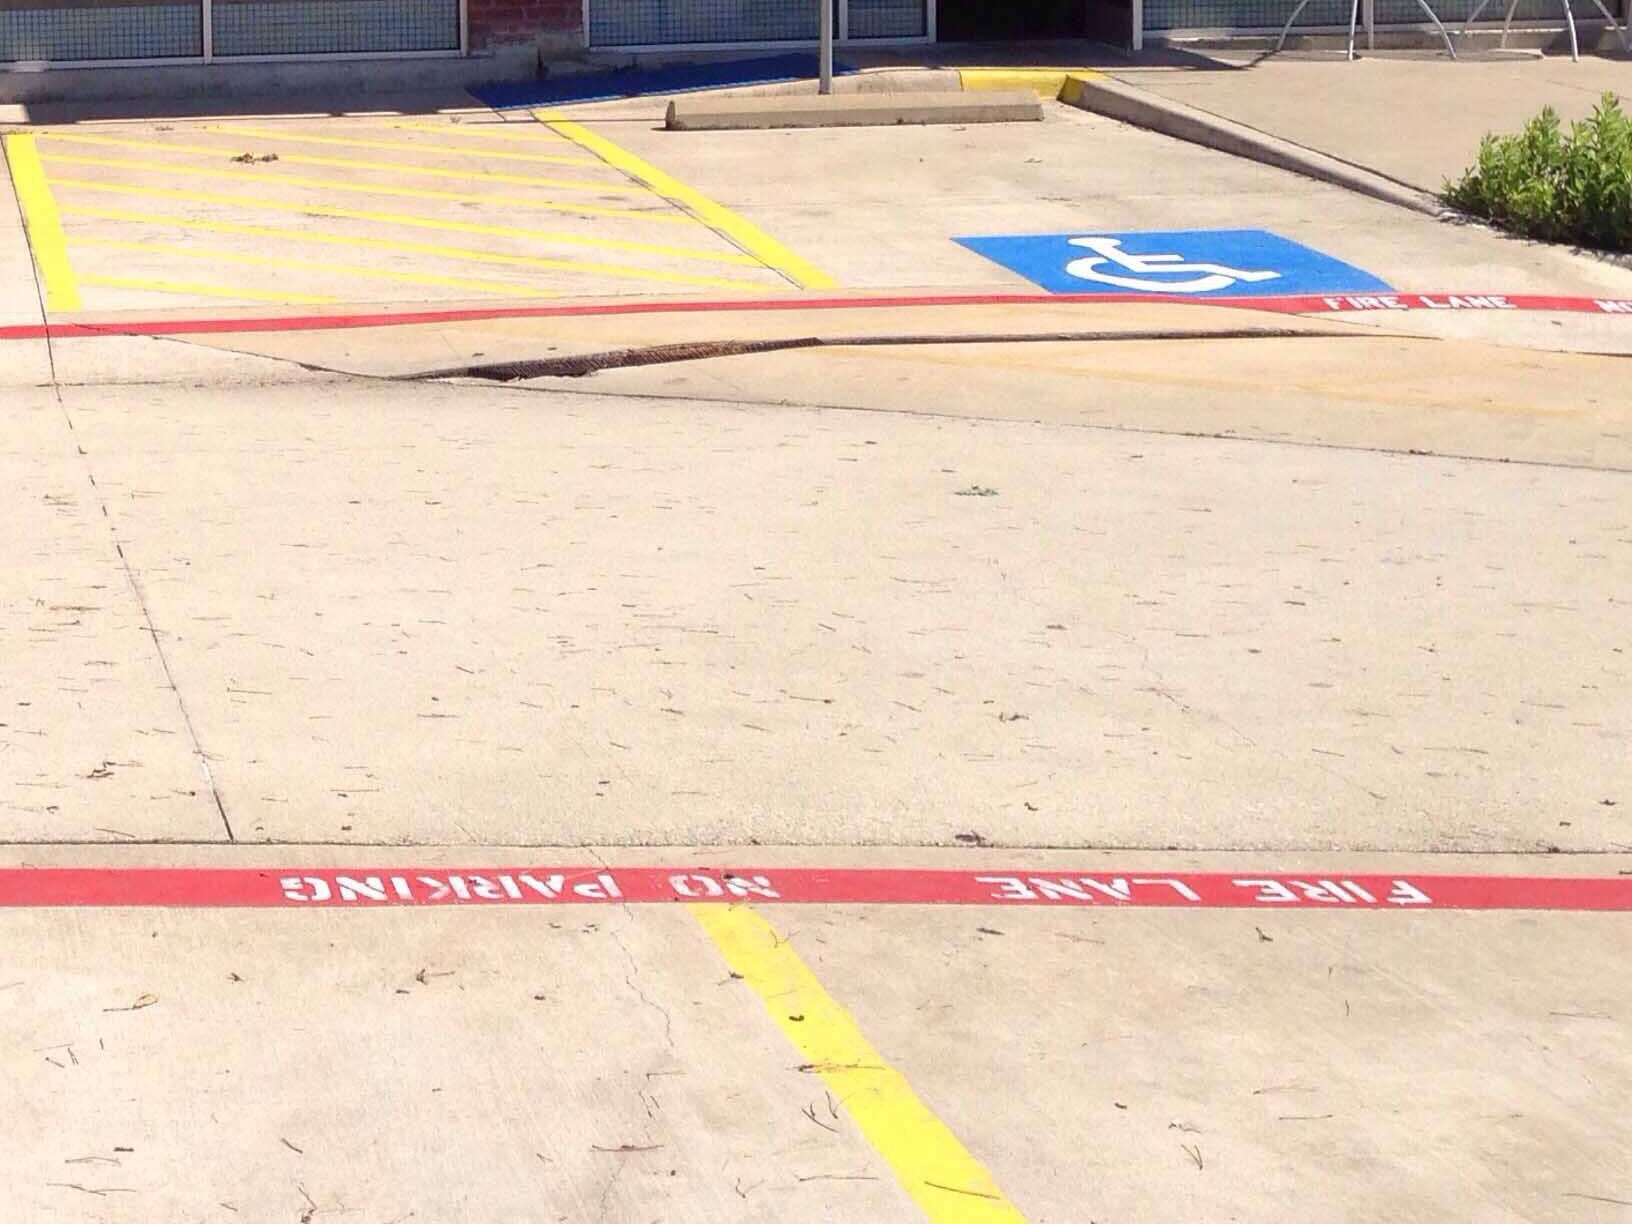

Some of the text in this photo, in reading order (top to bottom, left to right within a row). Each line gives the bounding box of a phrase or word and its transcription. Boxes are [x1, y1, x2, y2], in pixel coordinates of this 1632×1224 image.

[1323, 296, 1409, 310] FIRE
[1419, 295, 1518, 309] LANE
[280, 871, 1434, 905] FIRE LANE NO PARKING
